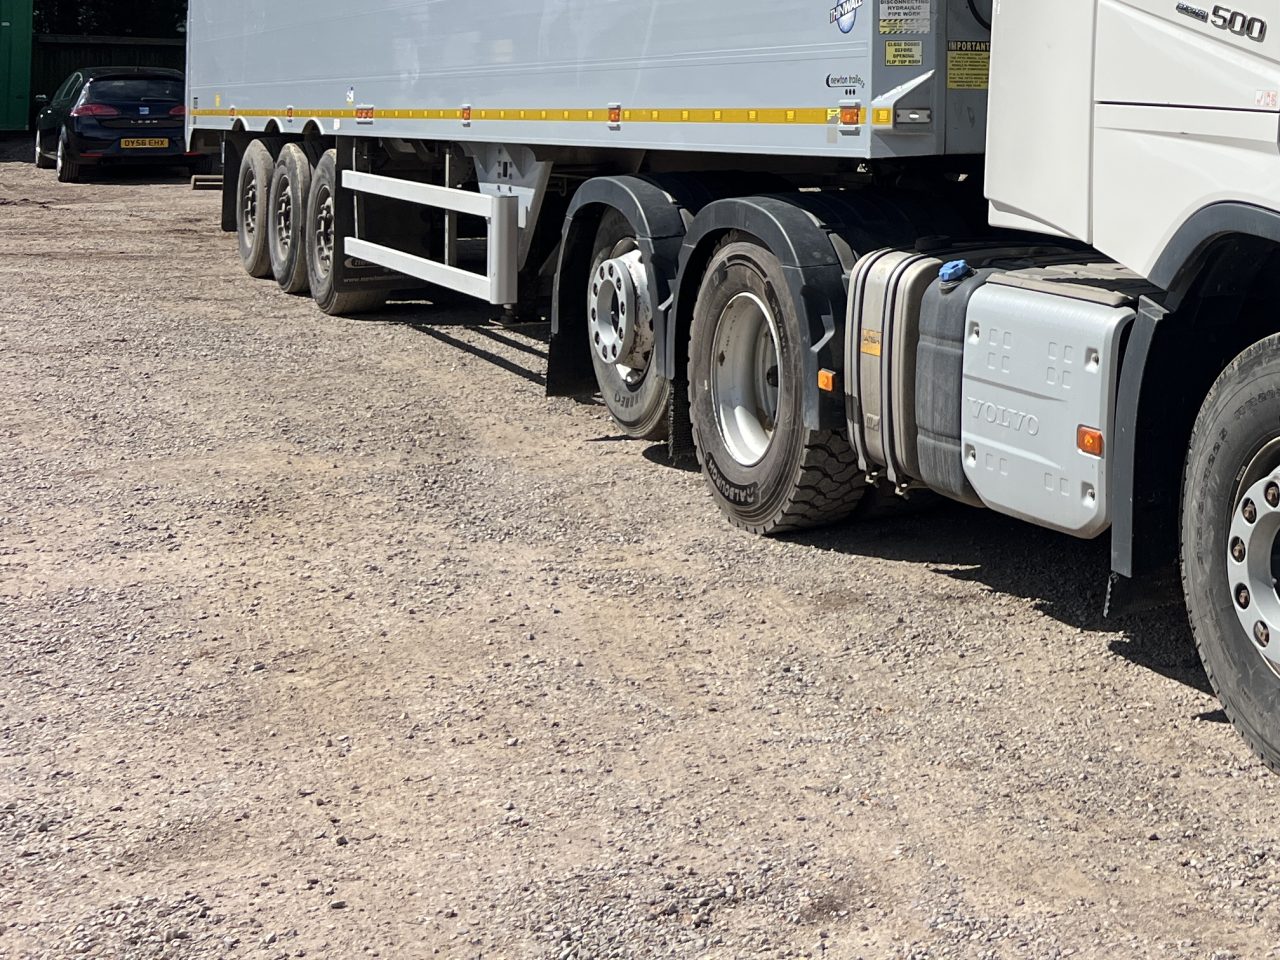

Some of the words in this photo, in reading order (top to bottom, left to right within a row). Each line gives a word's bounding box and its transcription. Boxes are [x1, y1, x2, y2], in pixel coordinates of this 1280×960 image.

[1210, 4, 1267, 43] 500
[948, 41, 990, 51] IMPORTANT
[967, 396, 1041, 437] VOLVO
